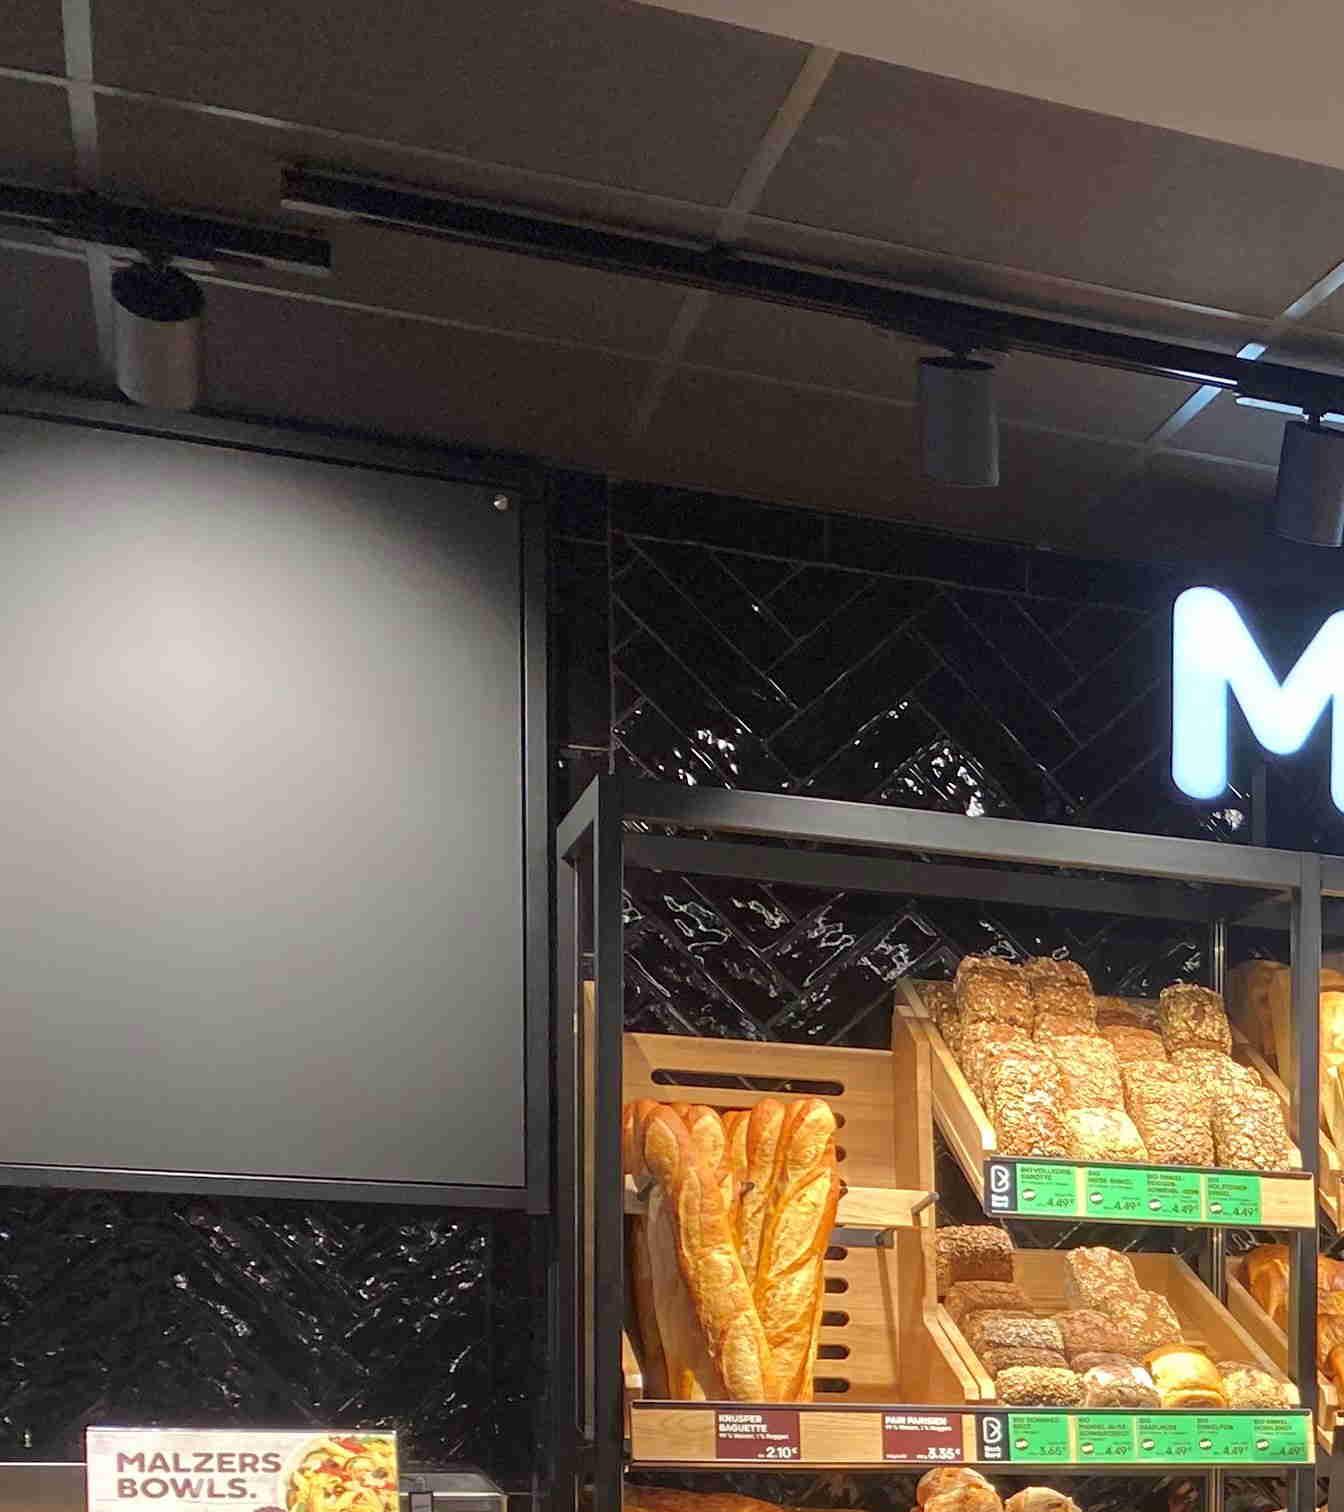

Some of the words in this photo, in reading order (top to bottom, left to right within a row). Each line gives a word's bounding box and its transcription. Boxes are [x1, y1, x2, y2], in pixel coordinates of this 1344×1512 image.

[718, 1414, 762, 1424] KNUSPER
[718, 1423, 768, 1433] BAGUETTE
[116, 1452, 282, 1473] MALZERS
[116, 1477, 257, 1499] BOWLS.
